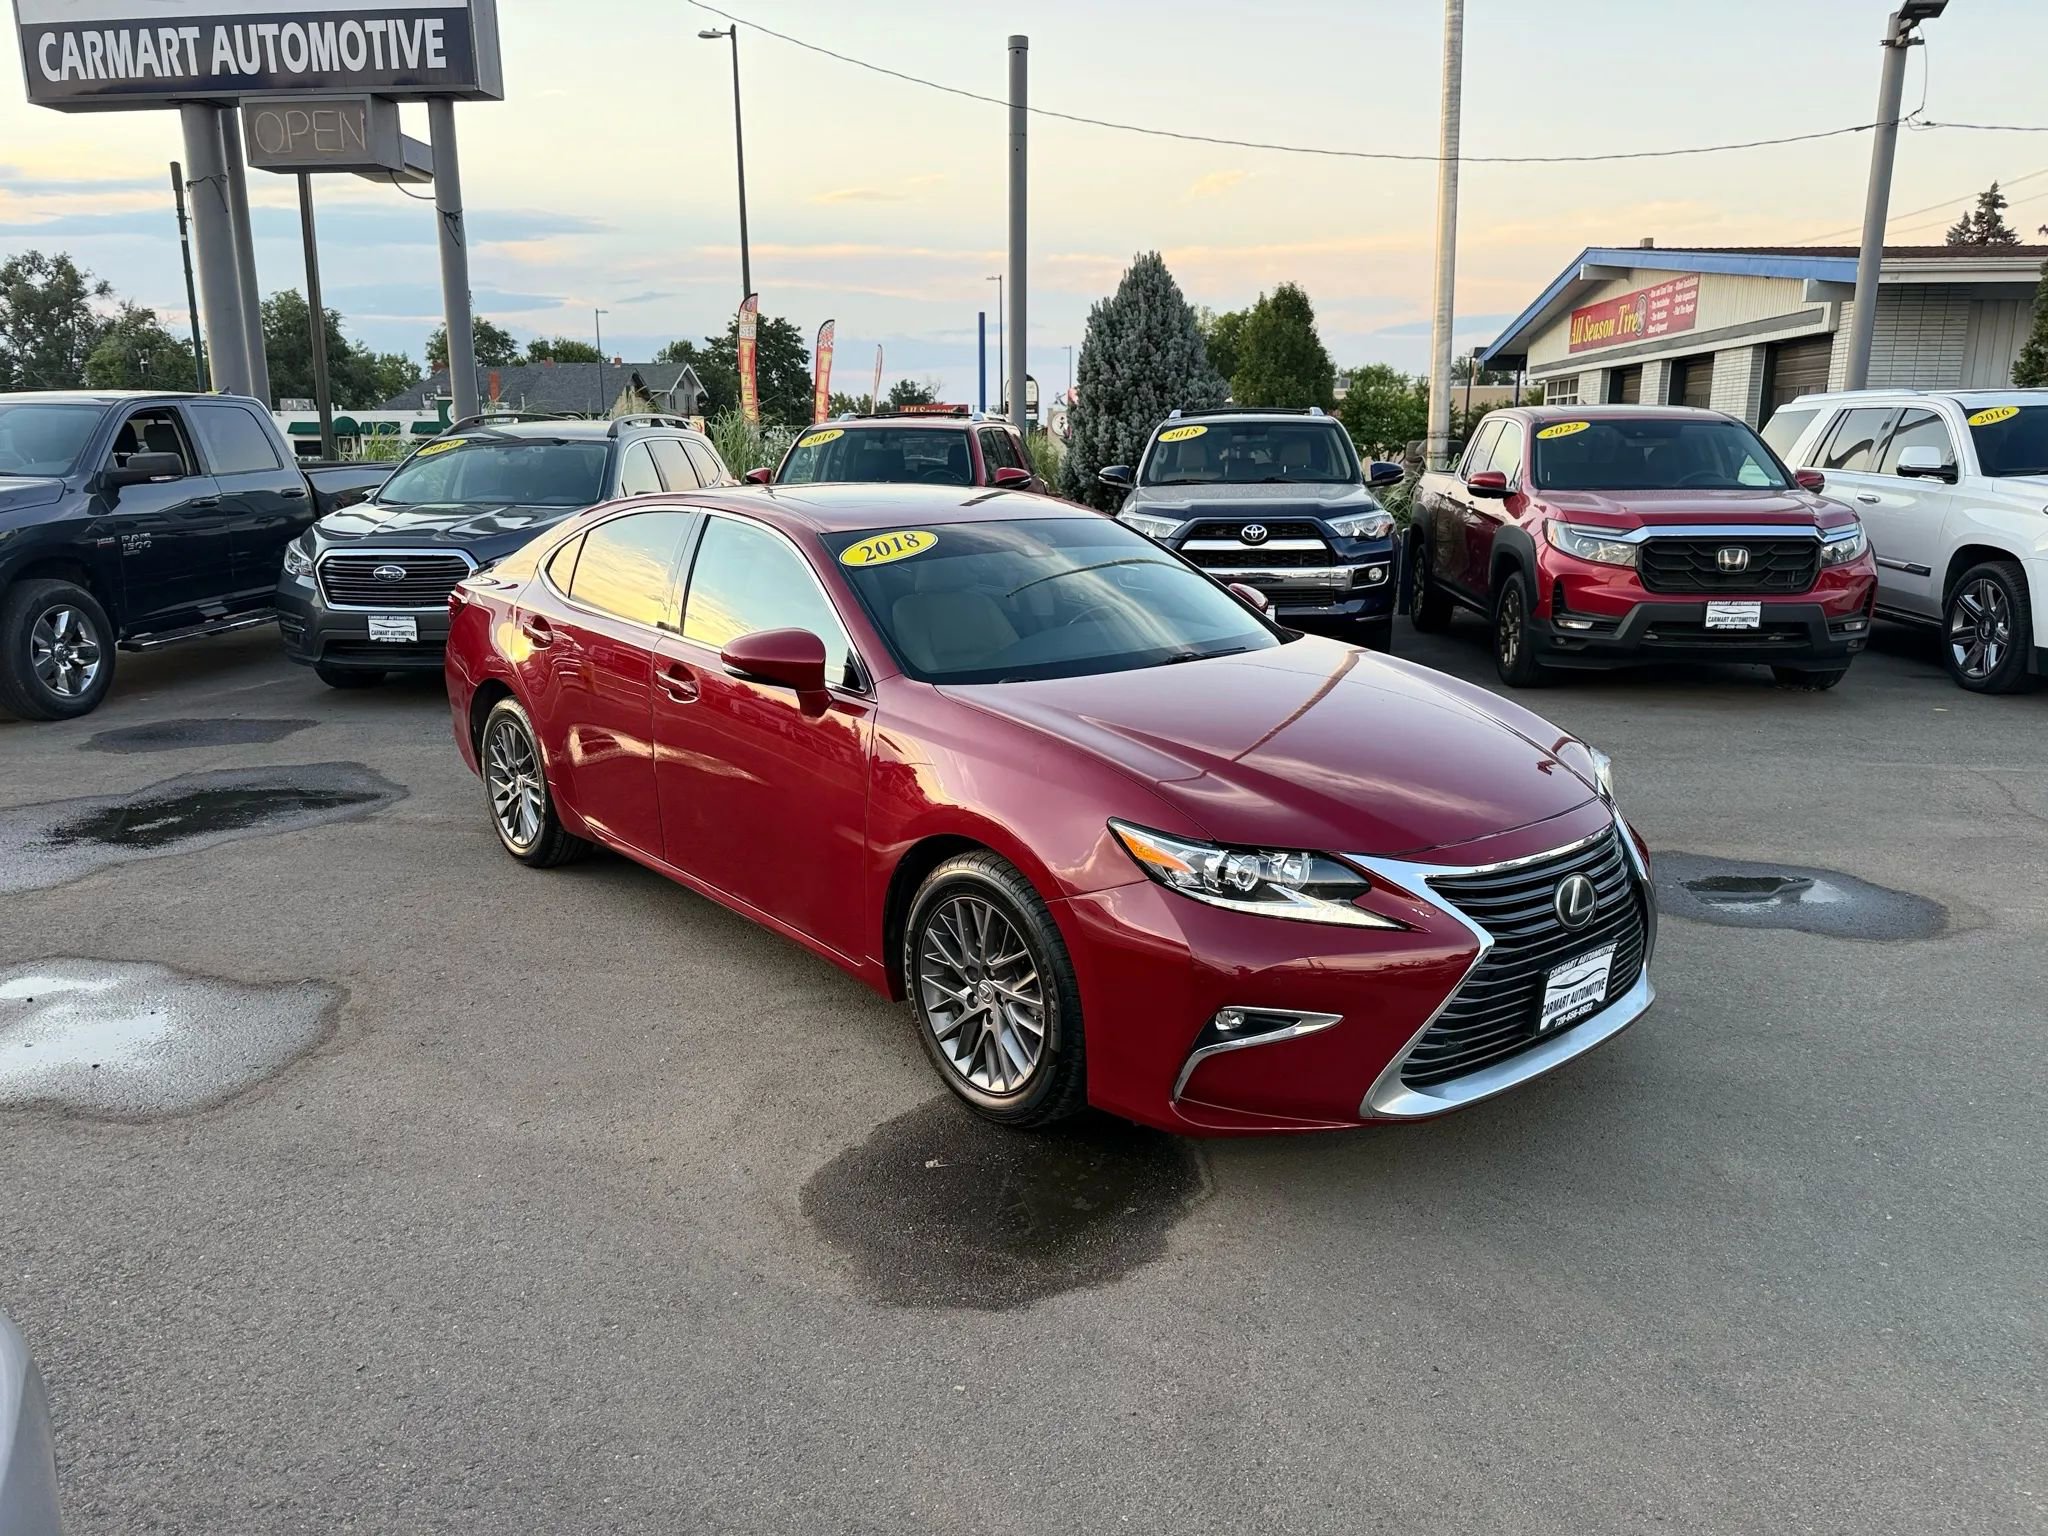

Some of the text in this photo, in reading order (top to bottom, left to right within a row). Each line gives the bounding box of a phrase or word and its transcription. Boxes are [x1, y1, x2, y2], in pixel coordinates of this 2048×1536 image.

[38, 18, 447, 82] CARMART AUTOMOTIVE
[255, 110, 366, 153] OPEN
[1570, 316, 1583, 345] All
[1583, 315, 1616, 342] Season
[1976, 407, 2010, 425] 2016
[807, 431, 835, 446] 2016
[1168, 427, 1199, 440] 2018
[1547, 423, 1579, 437] 2022
[121, 532, 151, 543] RAM
[122, 540, 152, 551] 1500
[859, 532, 921, 563] 2018
[1549, 942, 1618, 980] CARMART AUTOMOTIVE
[1542, 977, 1606, 1016] CARMART AUTOMOTIVE
